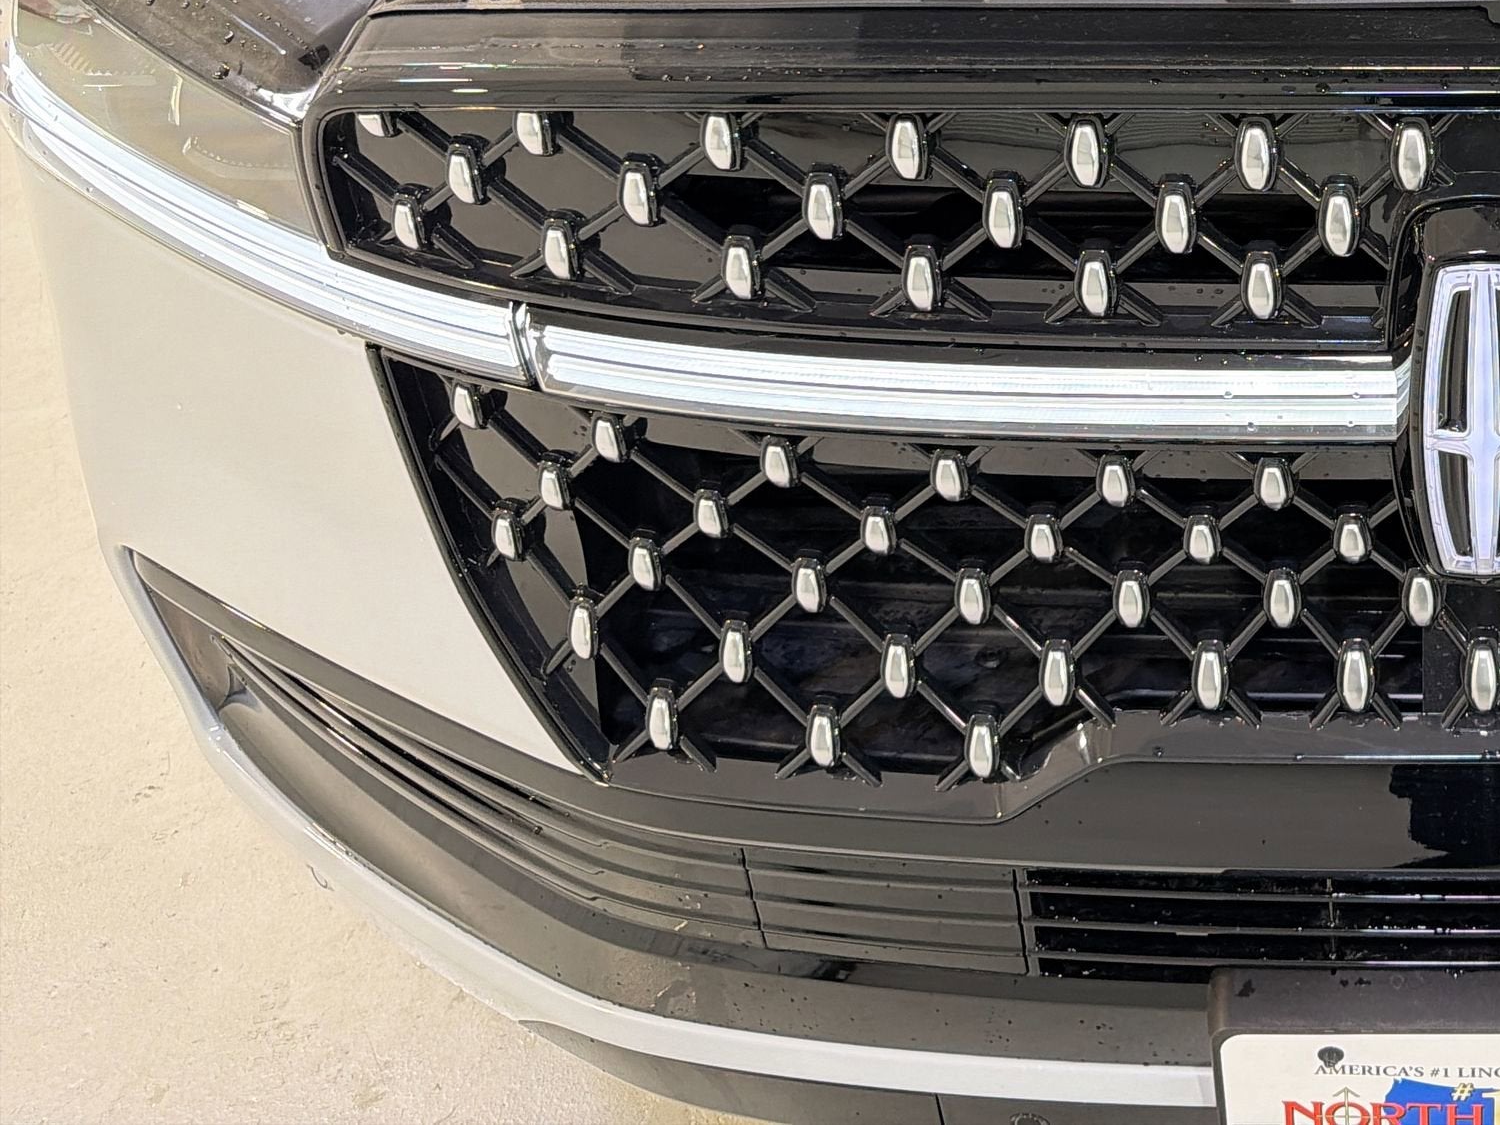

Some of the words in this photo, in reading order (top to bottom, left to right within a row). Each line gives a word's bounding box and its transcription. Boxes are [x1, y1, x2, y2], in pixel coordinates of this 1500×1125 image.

[1315, 1064, 1425, 1077] AMERICA'S
[1430, 1067, 1450, 1078] #1
[1282, 1100, 1486, 1125] NORTH
